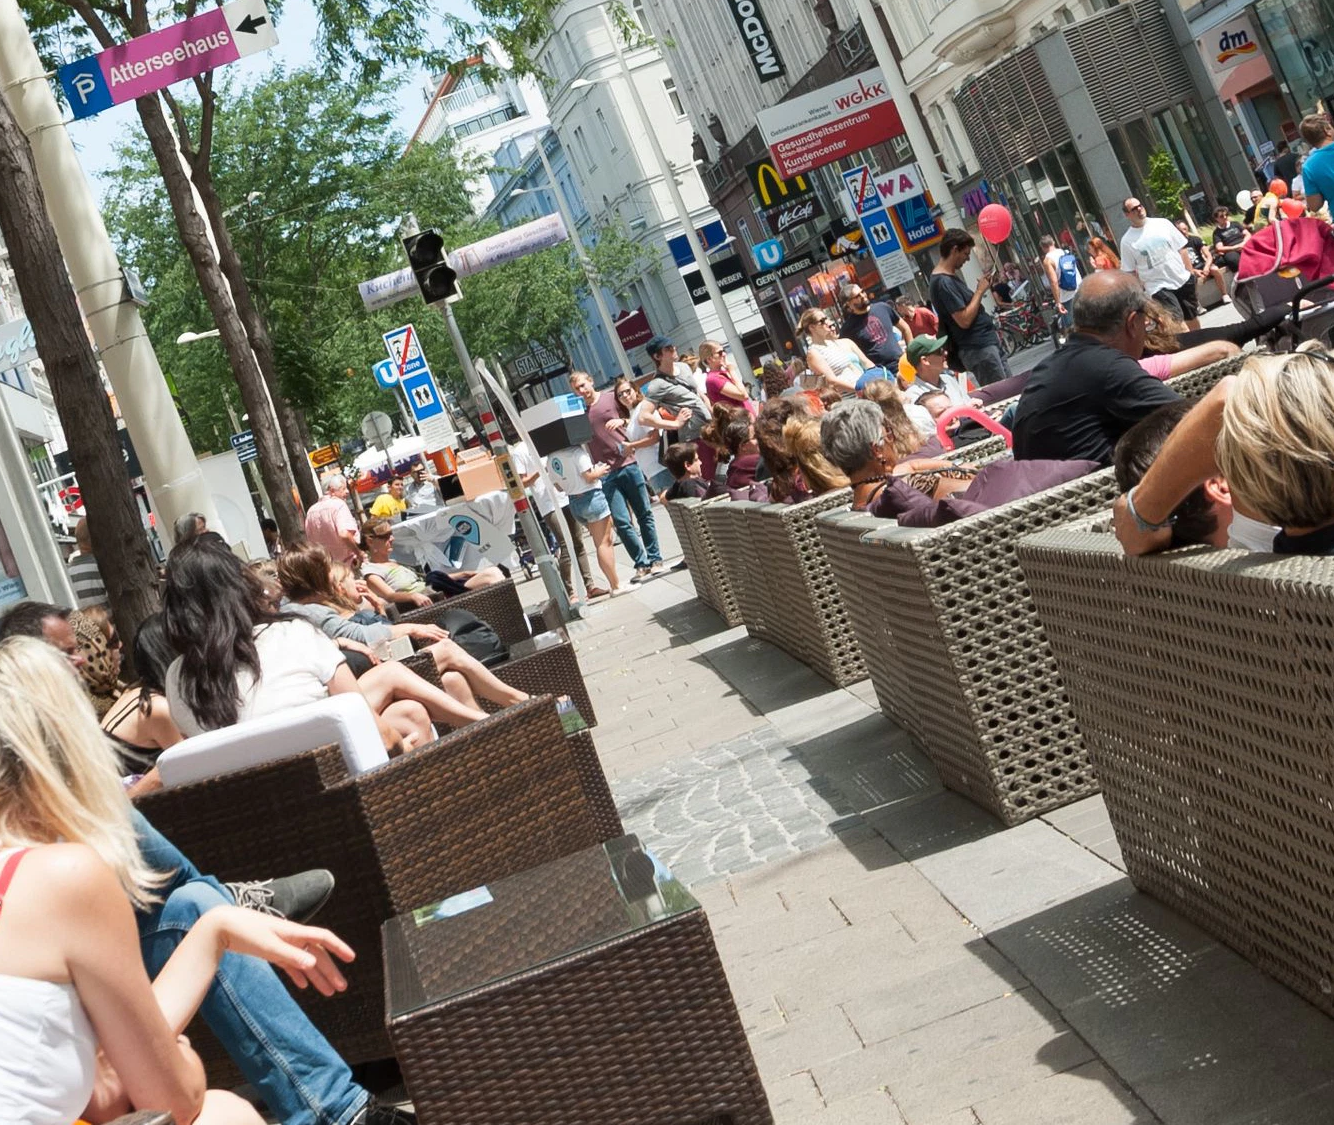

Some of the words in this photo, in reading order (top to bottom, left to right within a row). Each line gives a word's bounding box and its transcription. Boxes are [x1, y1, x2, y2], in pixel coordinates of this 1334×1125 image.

[1219, 29, 1249, 51] dm
[109, 29, 230, 88] Atterseehaus
[808, 104, 830, 116] Wiener
[770, 110, 832, 138] Gebietskrankenkasse
[777, 112, 871, 153] Gesundheitszentrum
[779, 139, 823, 159] Wien-Mariahilf
[782, 138, 848, 169] Kundencenter
[786, 161, 813, 175] Mariahilf
[907, 223, 936, 242] Hofer
[761, 243, 780, 264] U
[782, 257, 812, 275] WEBER
[717, 271, 744, 288] WEBER
[379, 363, 398, 384] U
[402, 360, 421, 372] Zone
[370, 455, 411, 474] WEN
